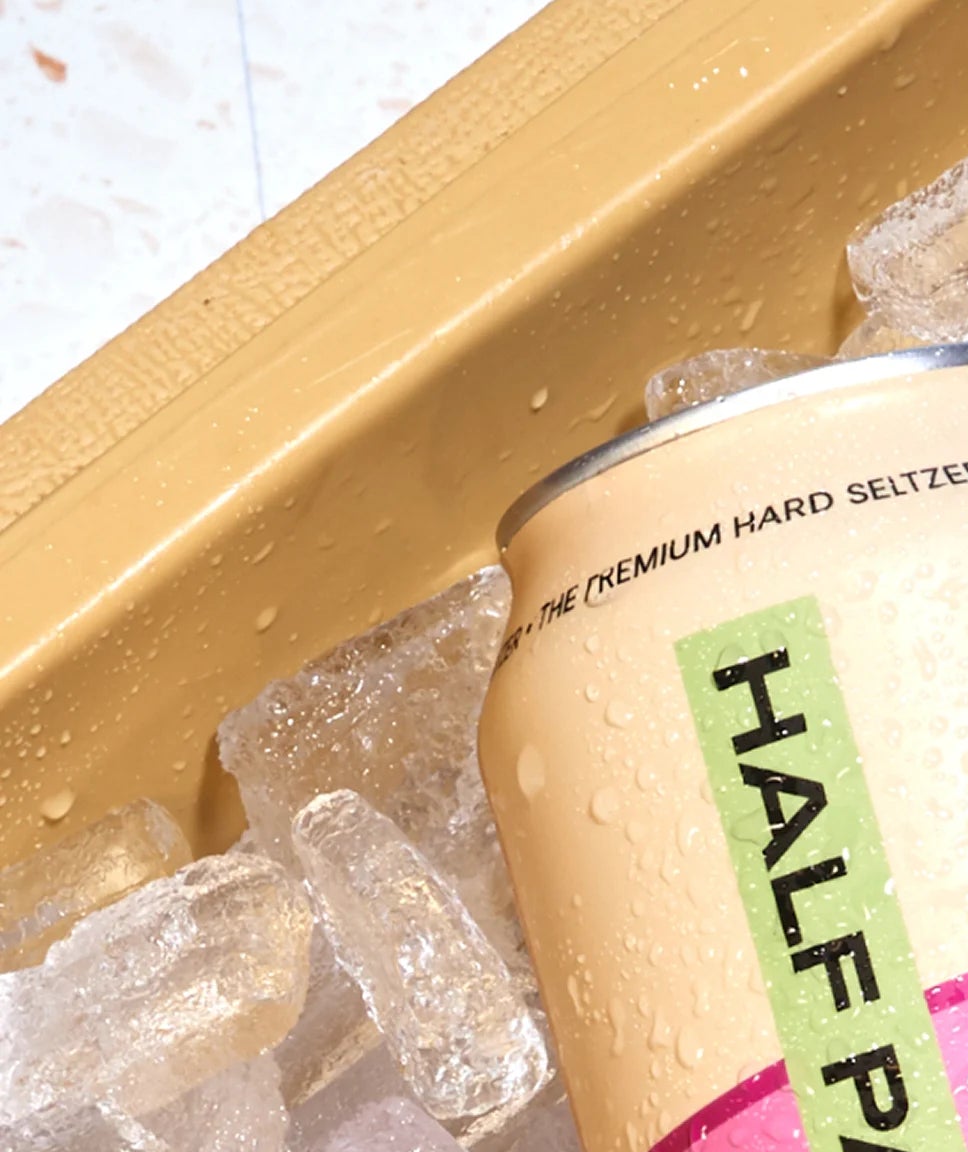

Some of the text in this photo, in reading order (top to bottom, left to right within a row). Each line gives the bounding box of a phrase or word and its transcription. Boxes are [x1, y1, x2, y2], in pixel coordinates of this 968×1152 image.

[538, 583, 579, 630] THE
[732, 490, 835, 539] HARD
[711, 646, 881, 1011] HALF
